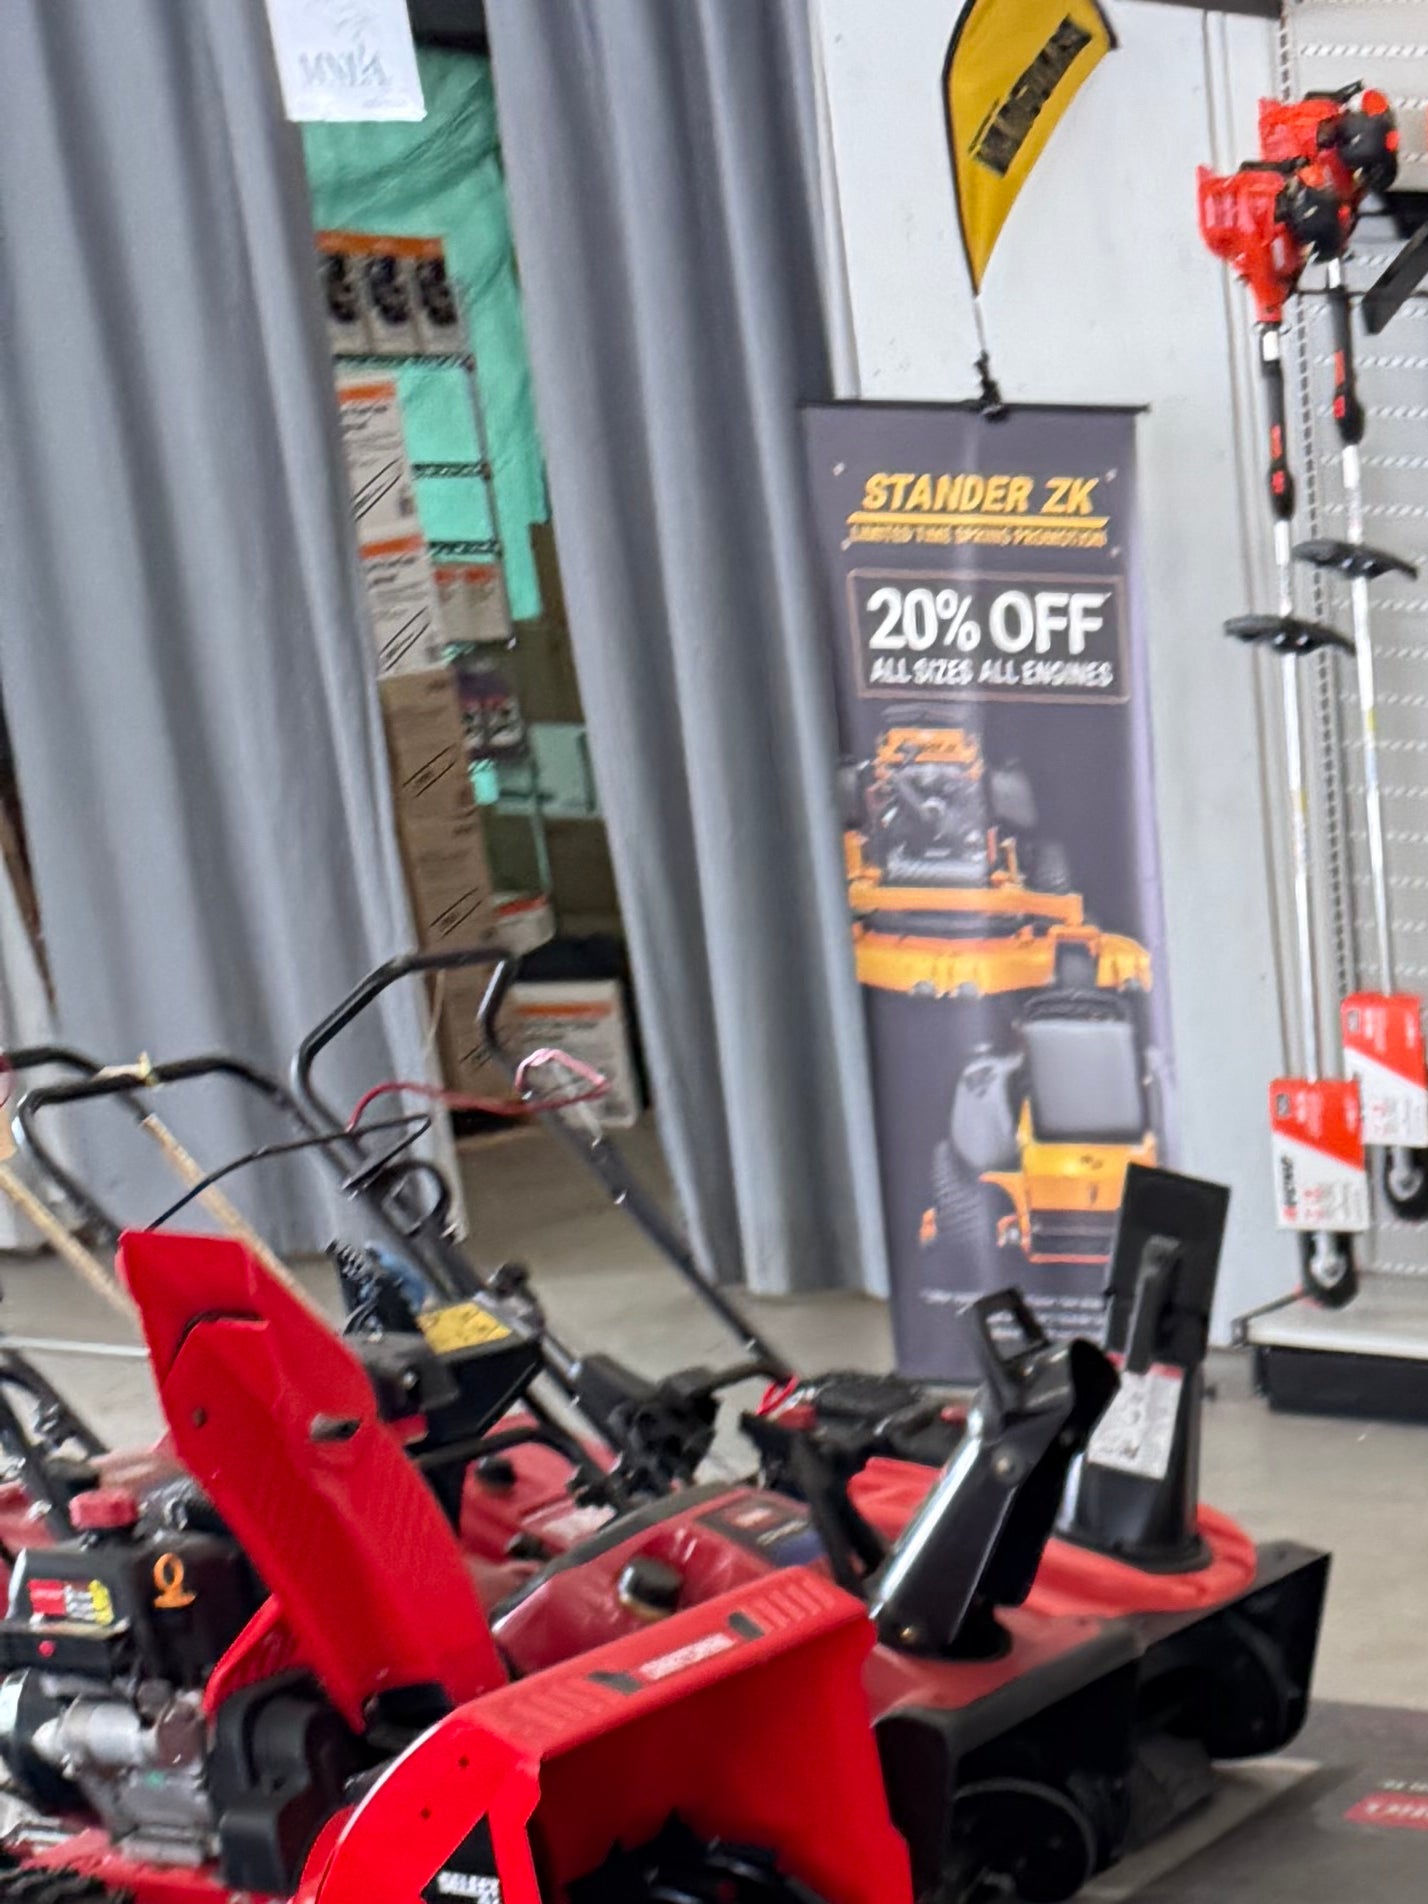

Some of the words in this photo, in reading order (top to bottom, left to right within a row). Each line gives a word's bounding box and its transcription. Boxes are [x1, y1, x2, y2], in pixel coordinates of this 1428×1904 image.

[861, 472, 1034, 513] STANDER
[1040, 476, 1099, 515] ZK
[866, 587, 981, 652] 20%
[989, 590, 1112, 655] OFF
[869, 656, 912, 684] ALL
[912, 657, 973, 685] SIZES
[978, 660, 1020, 684] ALL
[1023, 660, 1114, 687] ENGINES
